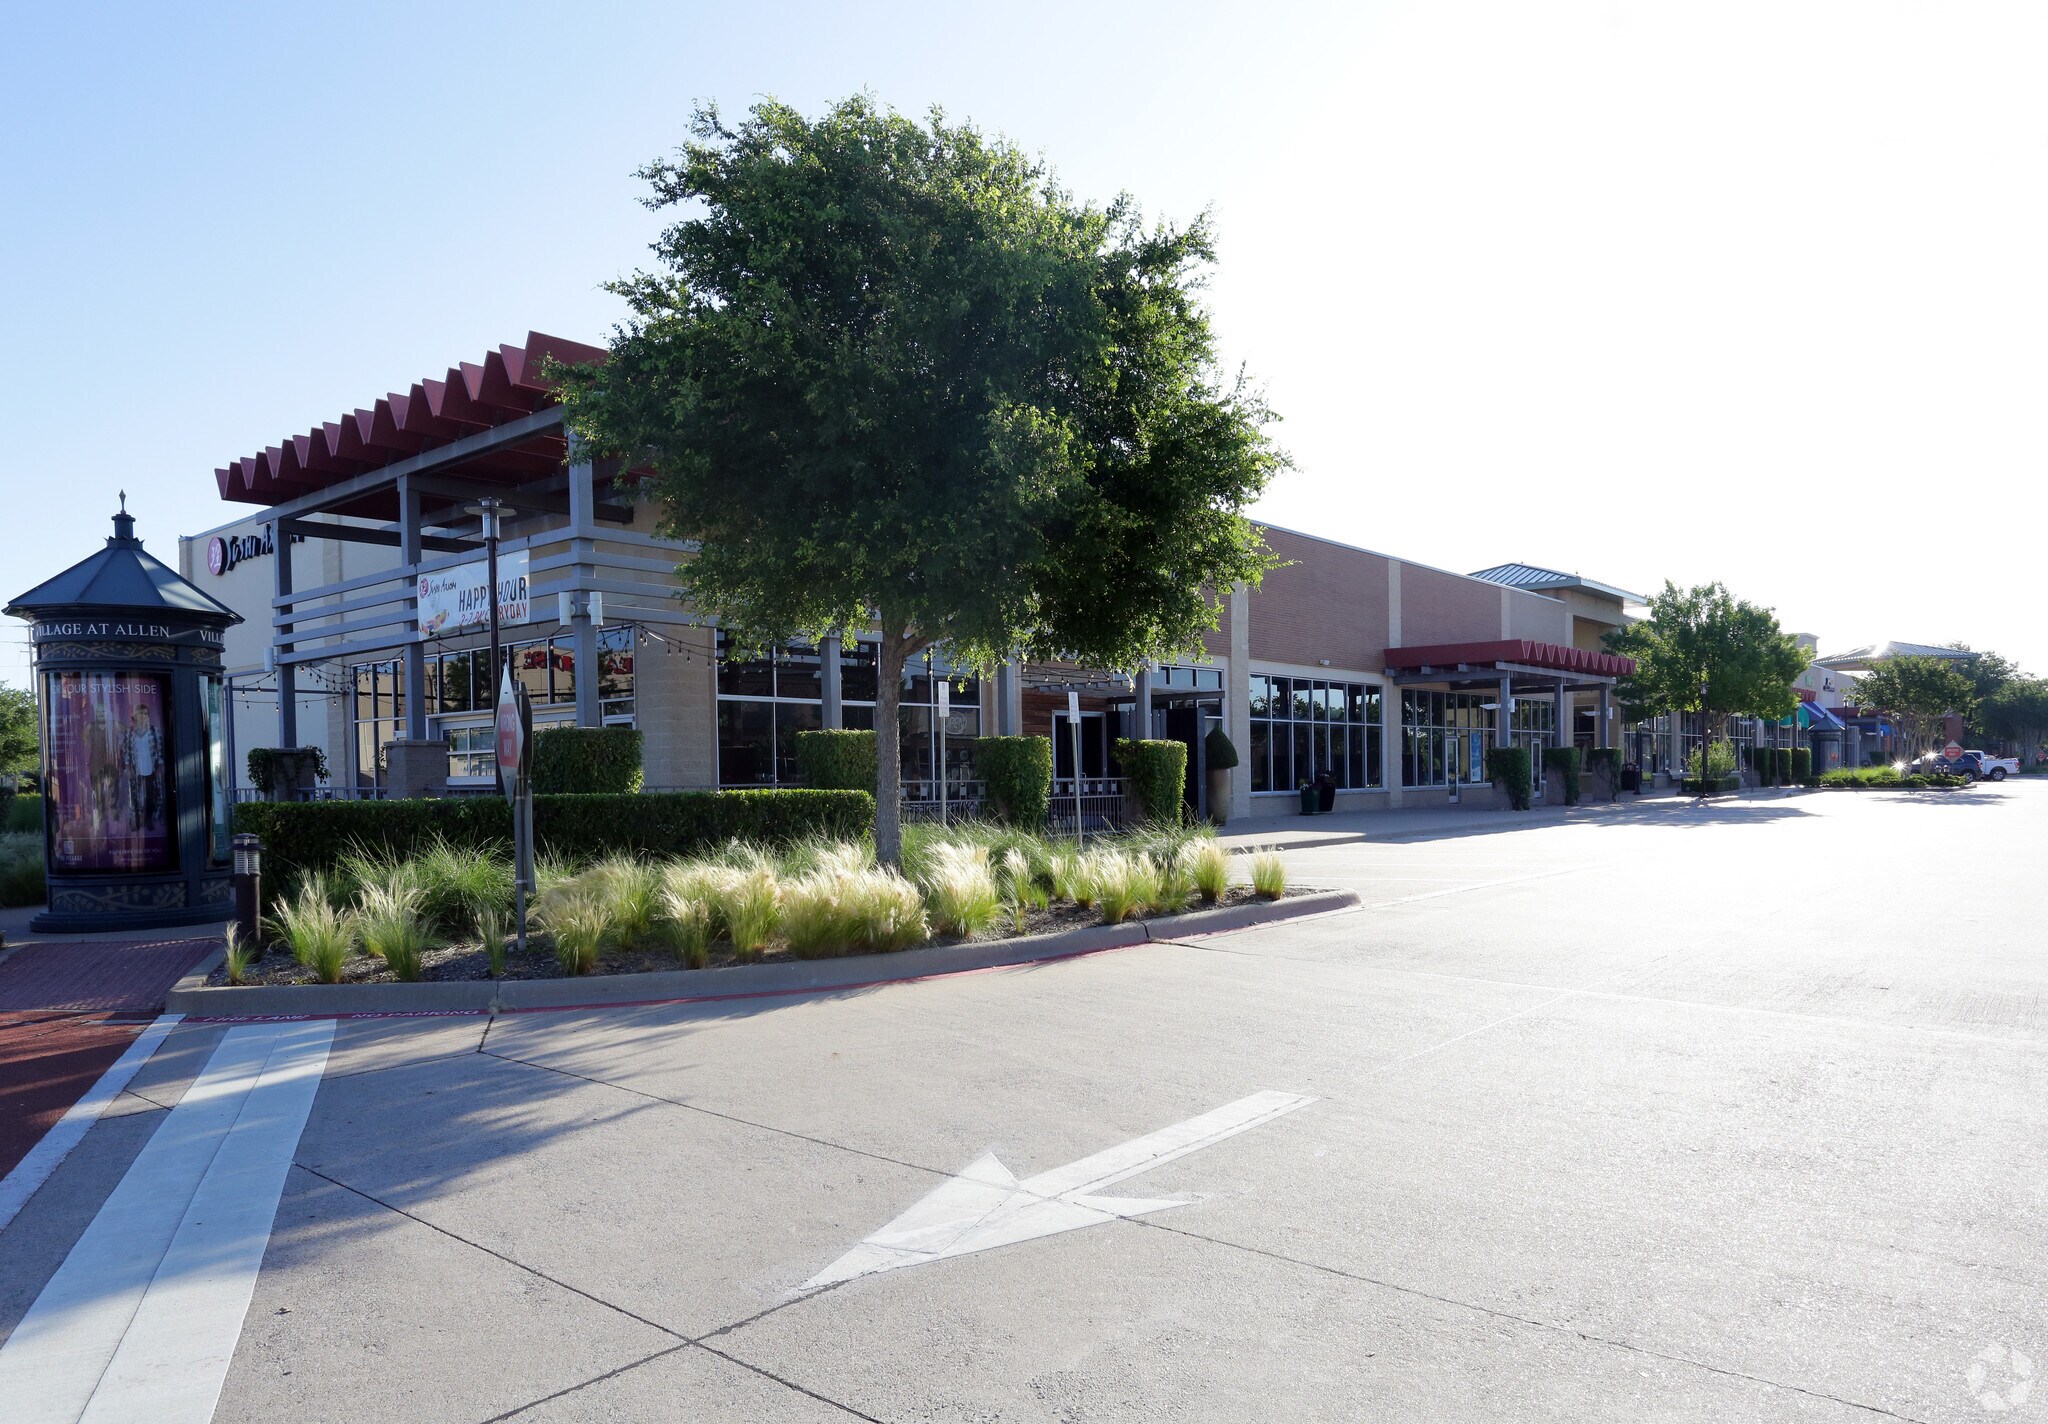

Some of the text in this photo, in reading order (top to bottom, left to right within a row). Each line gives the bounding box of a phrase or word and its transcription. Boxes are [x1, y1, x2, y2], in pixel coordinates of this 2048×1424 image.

[458, 584, 491, 612] HAPP
[497, 576, 527, 604] HOUR
[484, 602, 528, 623] ERYDAY
[86, 623, 110, 635] AT
[114, 624, 170, 638] ALLEN
[90, 683, 131, 694] STYLISH
[134, 684, 157, 694] SIDE
